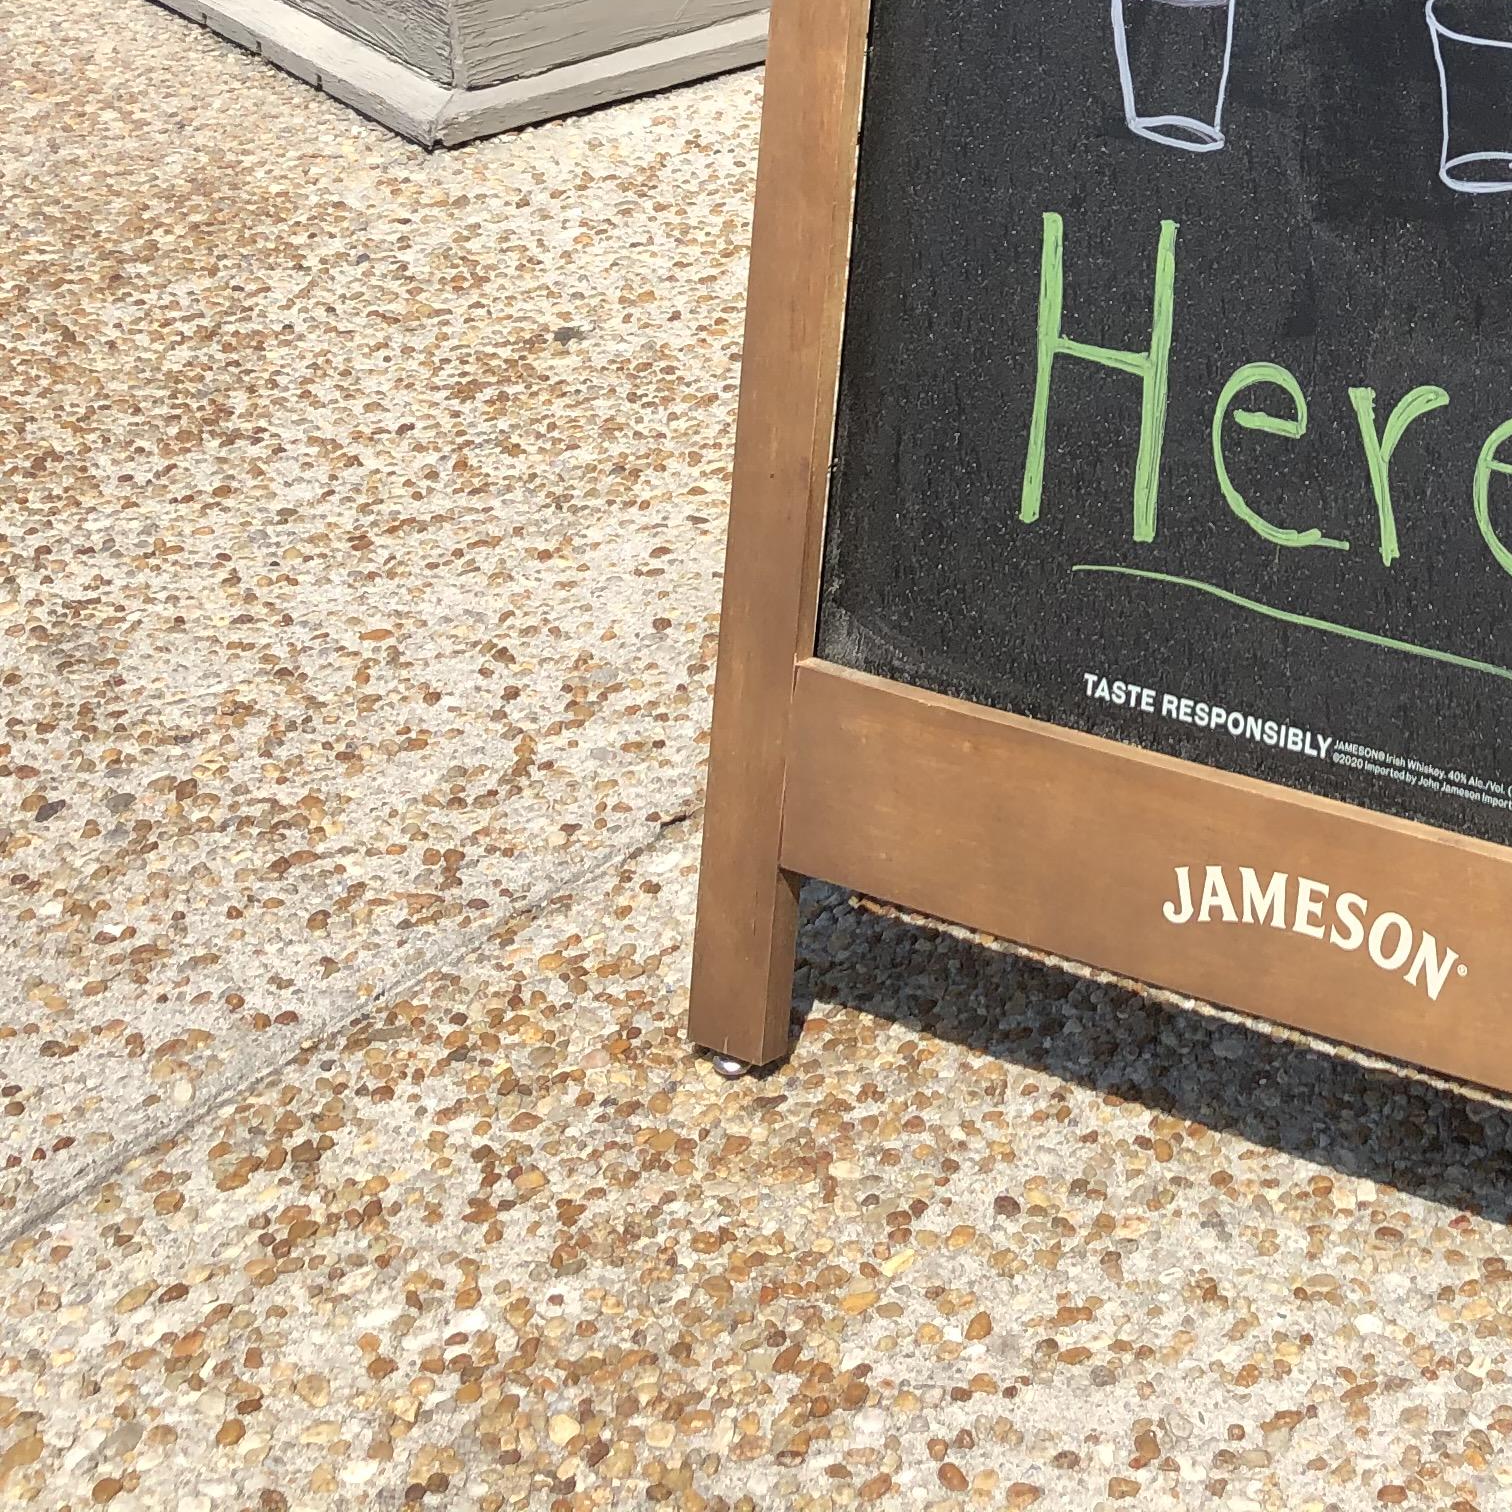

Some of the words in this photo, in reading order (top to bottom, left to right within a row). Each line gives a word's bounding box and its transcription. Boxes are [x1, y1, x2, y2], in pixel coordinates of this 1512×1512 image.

[1083, 672, 1157, 712] TASTE
[1161, 693, 1333, 759] RESPONSIBLY
[1364, 760, 1405, 781] Imported
[1406, 773, 1417, 786] by
[1418, 775, 1440, 791] John
[1441, 781, 1481, 801] Jameson
[1482, 792, 1512, 810] Import
[1386, 753, 1406, 767] Irish
[1448, 770, 1467, 785] 40%
